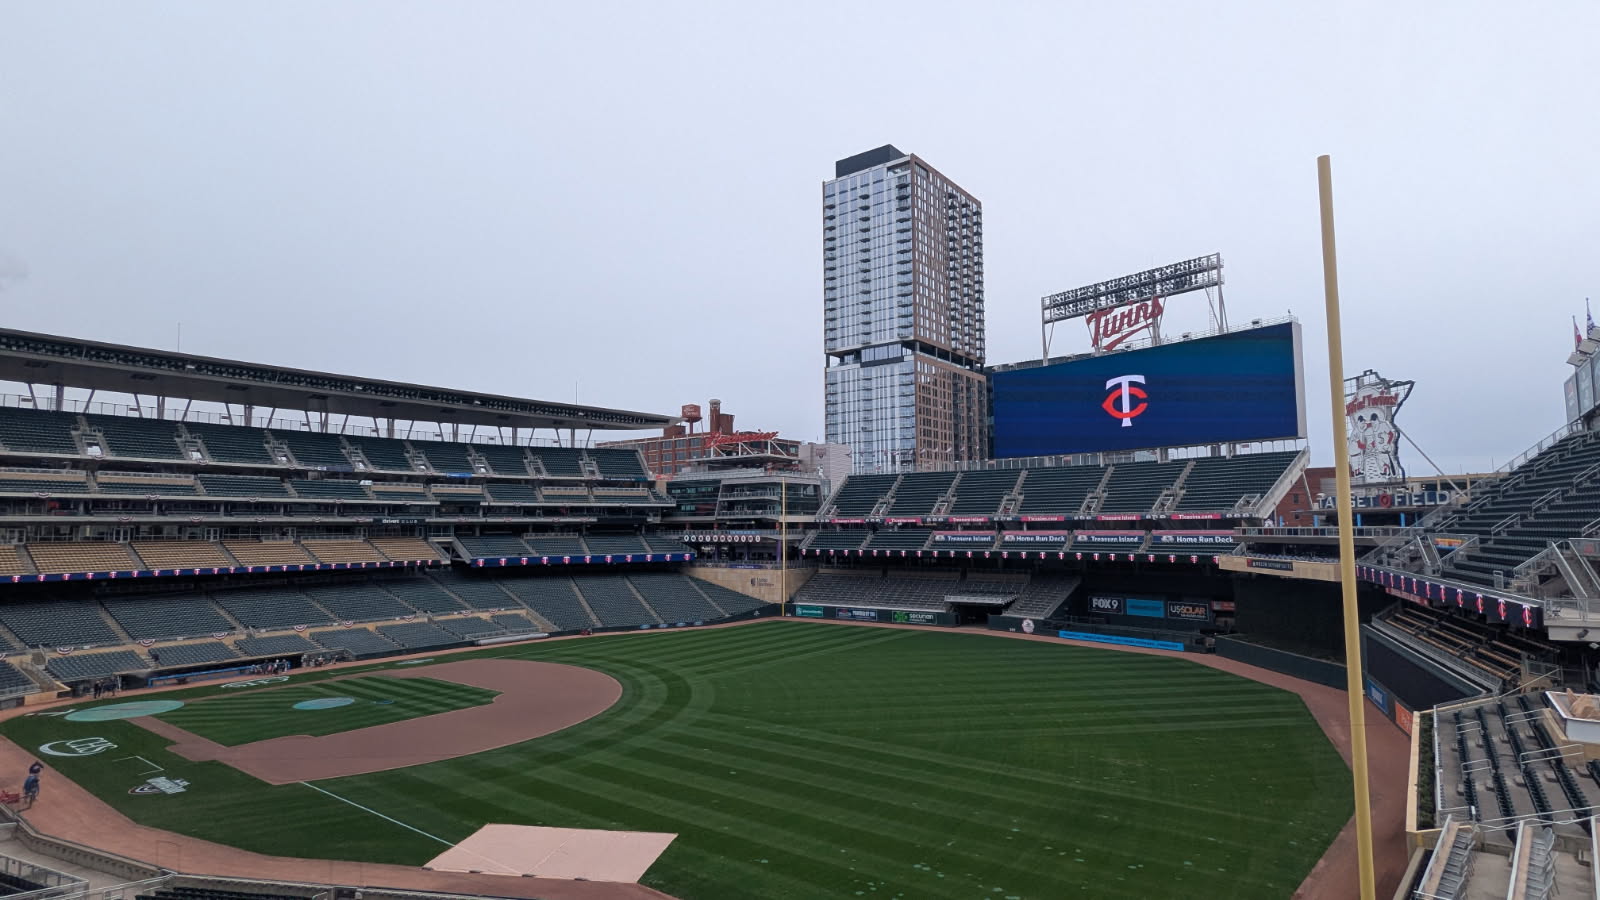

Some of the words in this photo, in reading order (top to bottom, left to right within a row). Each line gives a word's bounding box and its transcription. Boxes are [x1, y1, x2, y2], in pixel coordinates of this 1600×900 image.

[1086, 296, 1163, 348] Twins
[1317, 493, 1377, 509] TAGET
[1394, 490, 1450, 507] FIELD
[1092, 598, 1111, 609] FOX
[1111, 599, 1119, 609] 9
